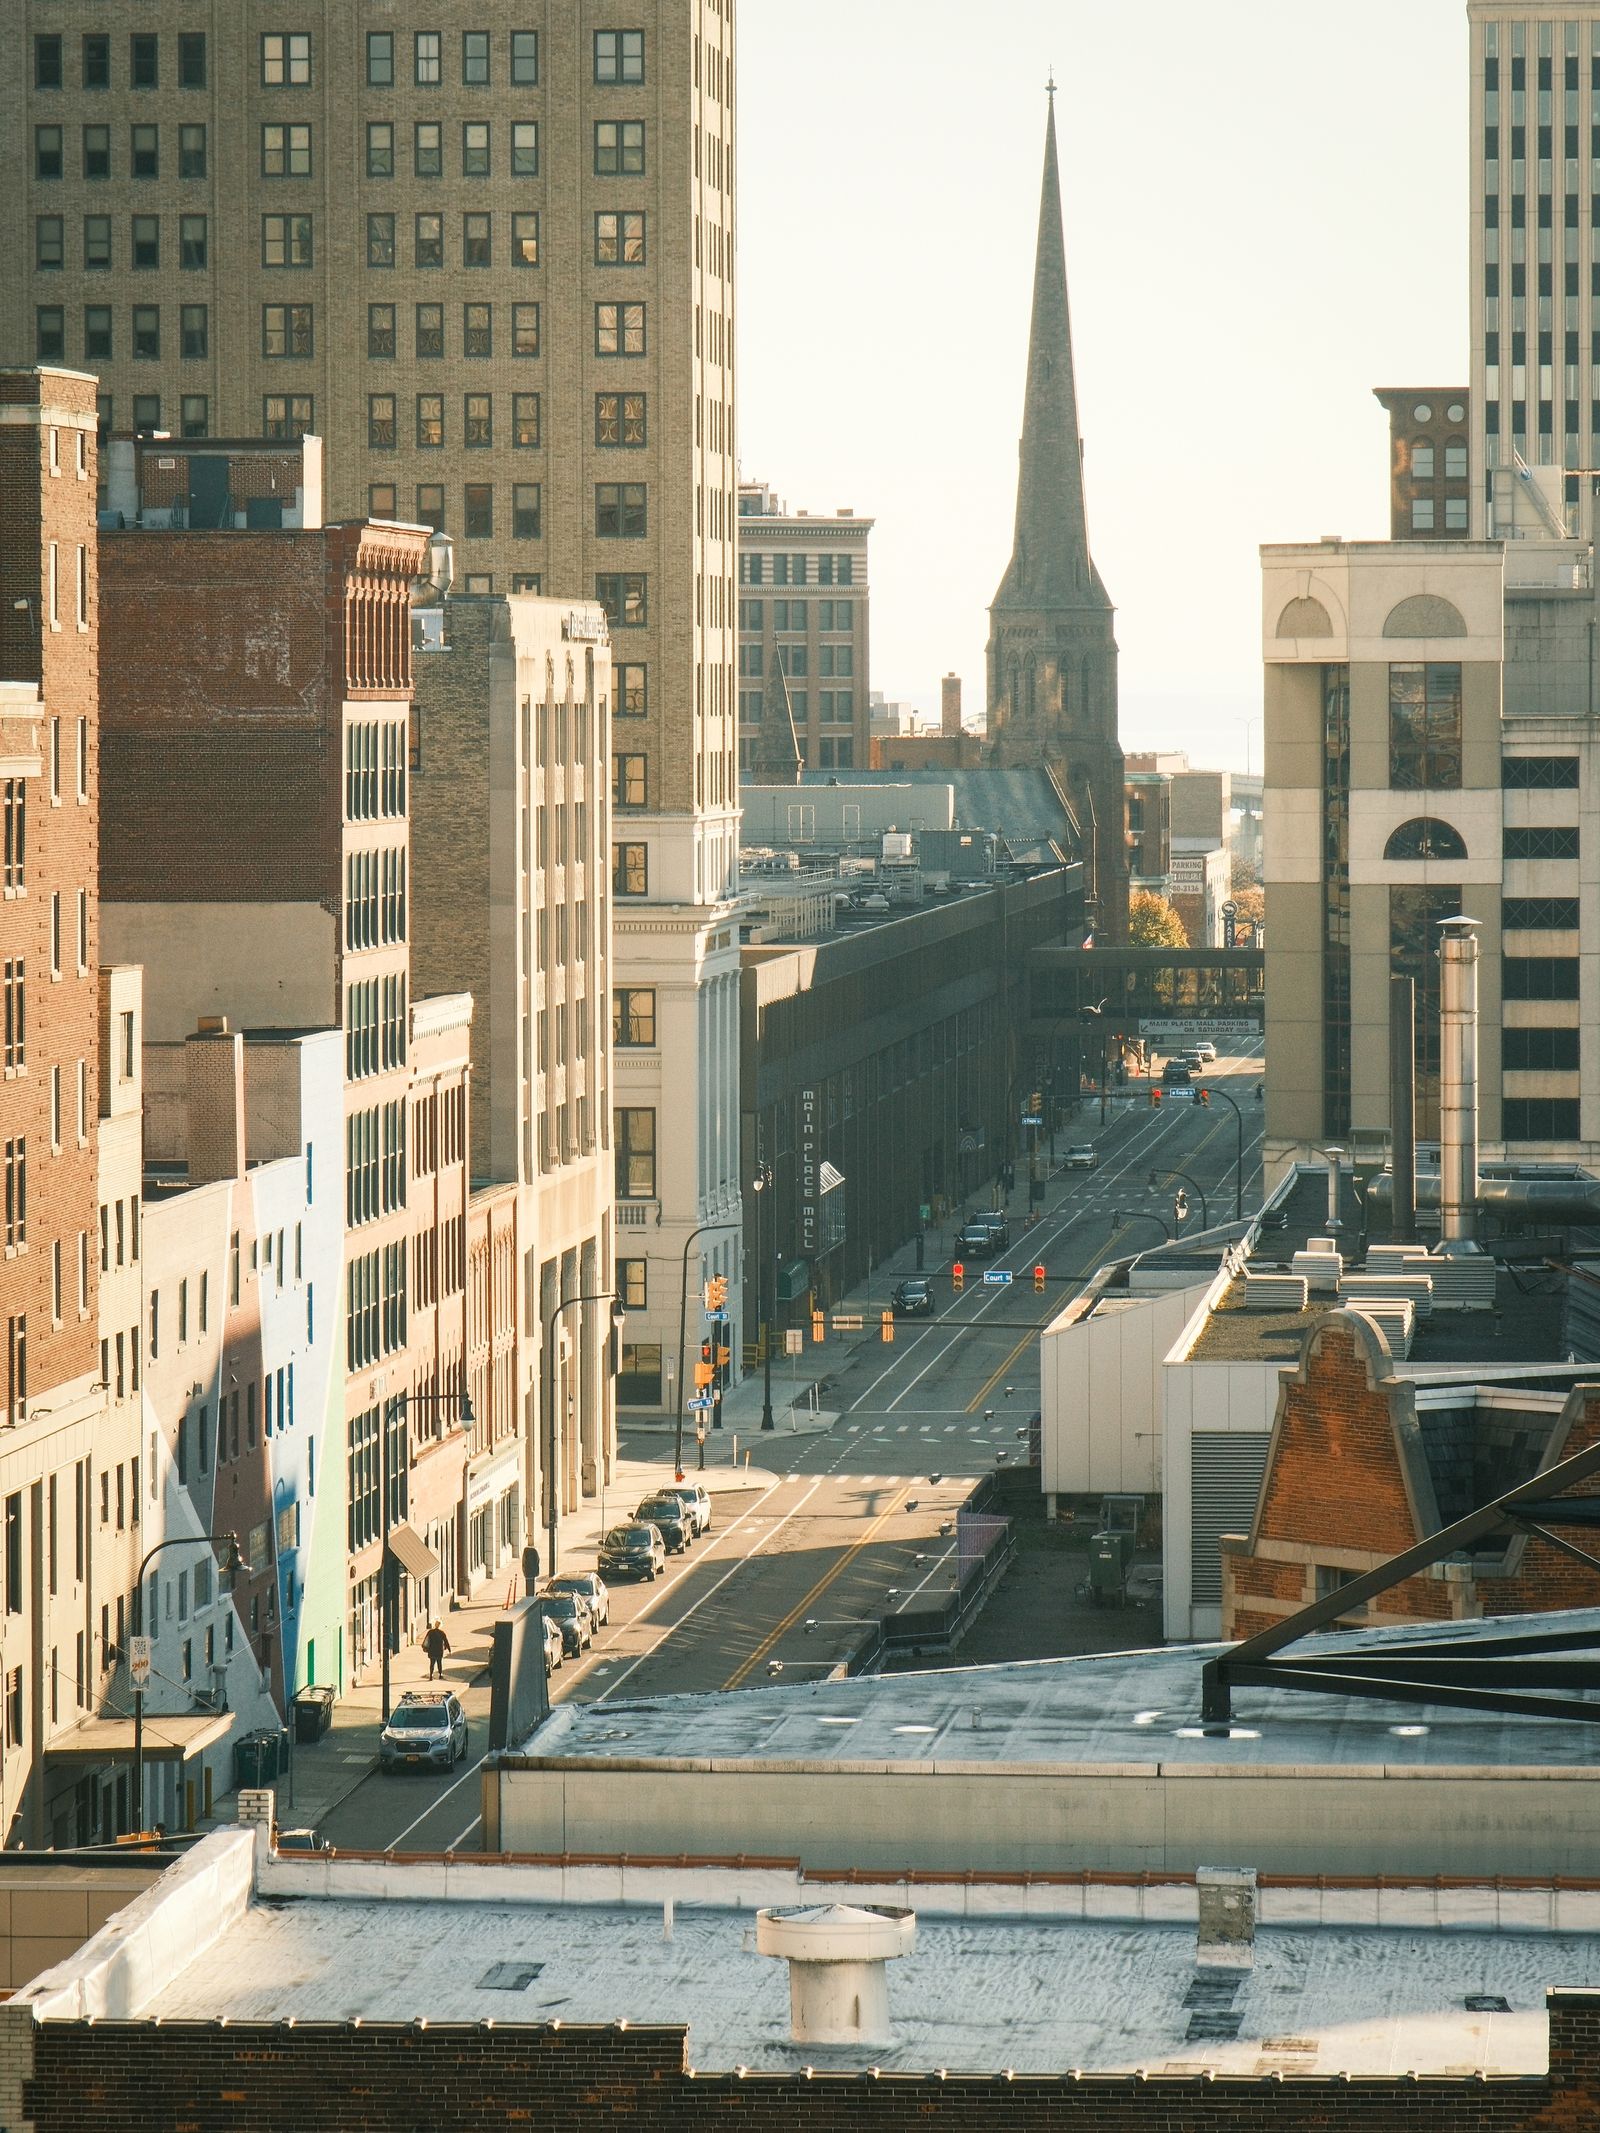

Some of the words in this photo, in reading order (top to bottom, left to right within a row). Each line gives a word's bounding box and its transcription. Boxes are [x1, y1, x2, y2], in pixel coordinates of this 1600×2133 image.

[1172, 861, 1202, 869] PARKING
[802, 1090, 814, 1134] MAIN
[803, 1143, 814, 1197] PLACE
[803, 1206, 814, 1248] MALL
[689, 1401, 702, 1409] Court
